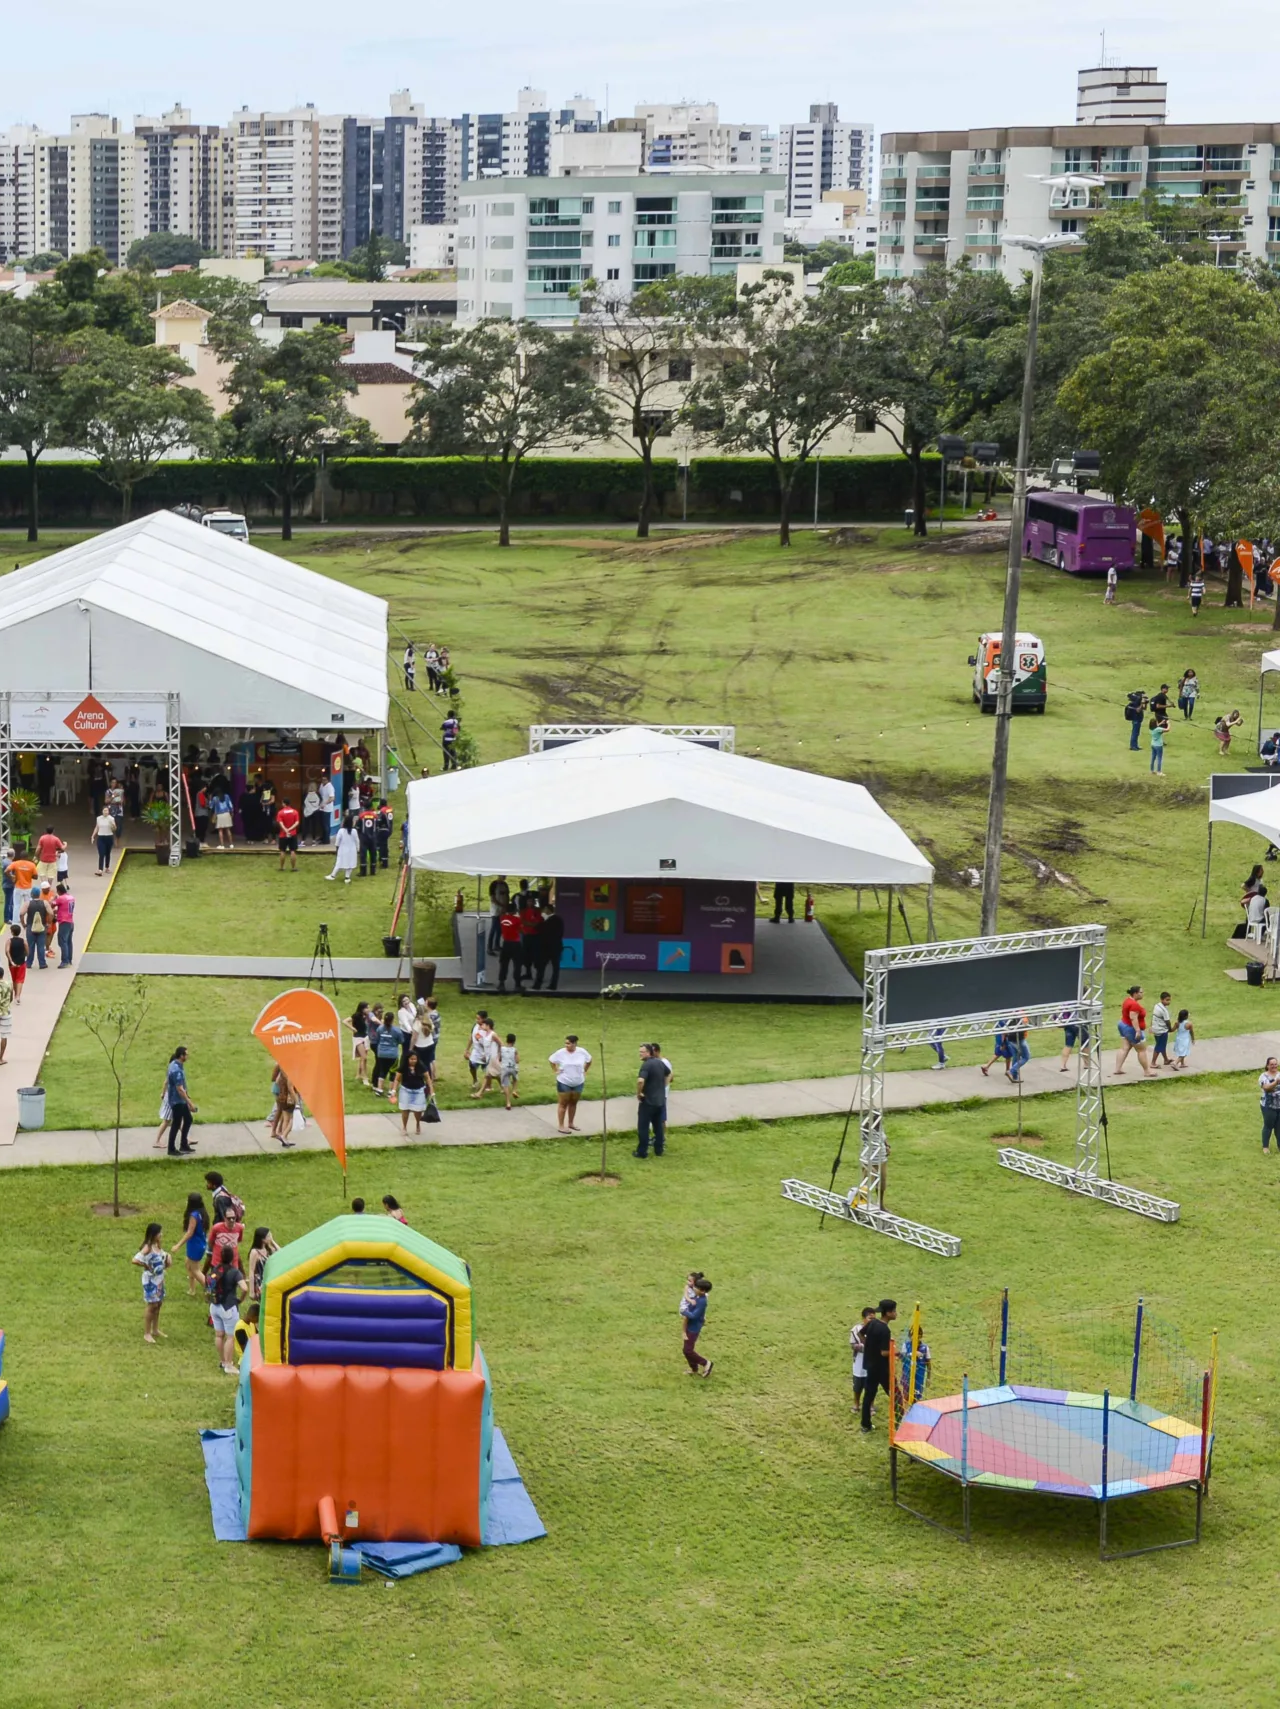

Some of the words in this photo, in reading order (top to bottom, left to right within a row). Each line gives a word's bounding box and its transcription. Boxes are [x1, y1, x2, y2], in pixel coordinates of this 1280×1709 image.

[77, 711, 104, 720] Arena
[74, 720, 107, 730] Cultural
[595, 951, 646, 961] Protagonismo
